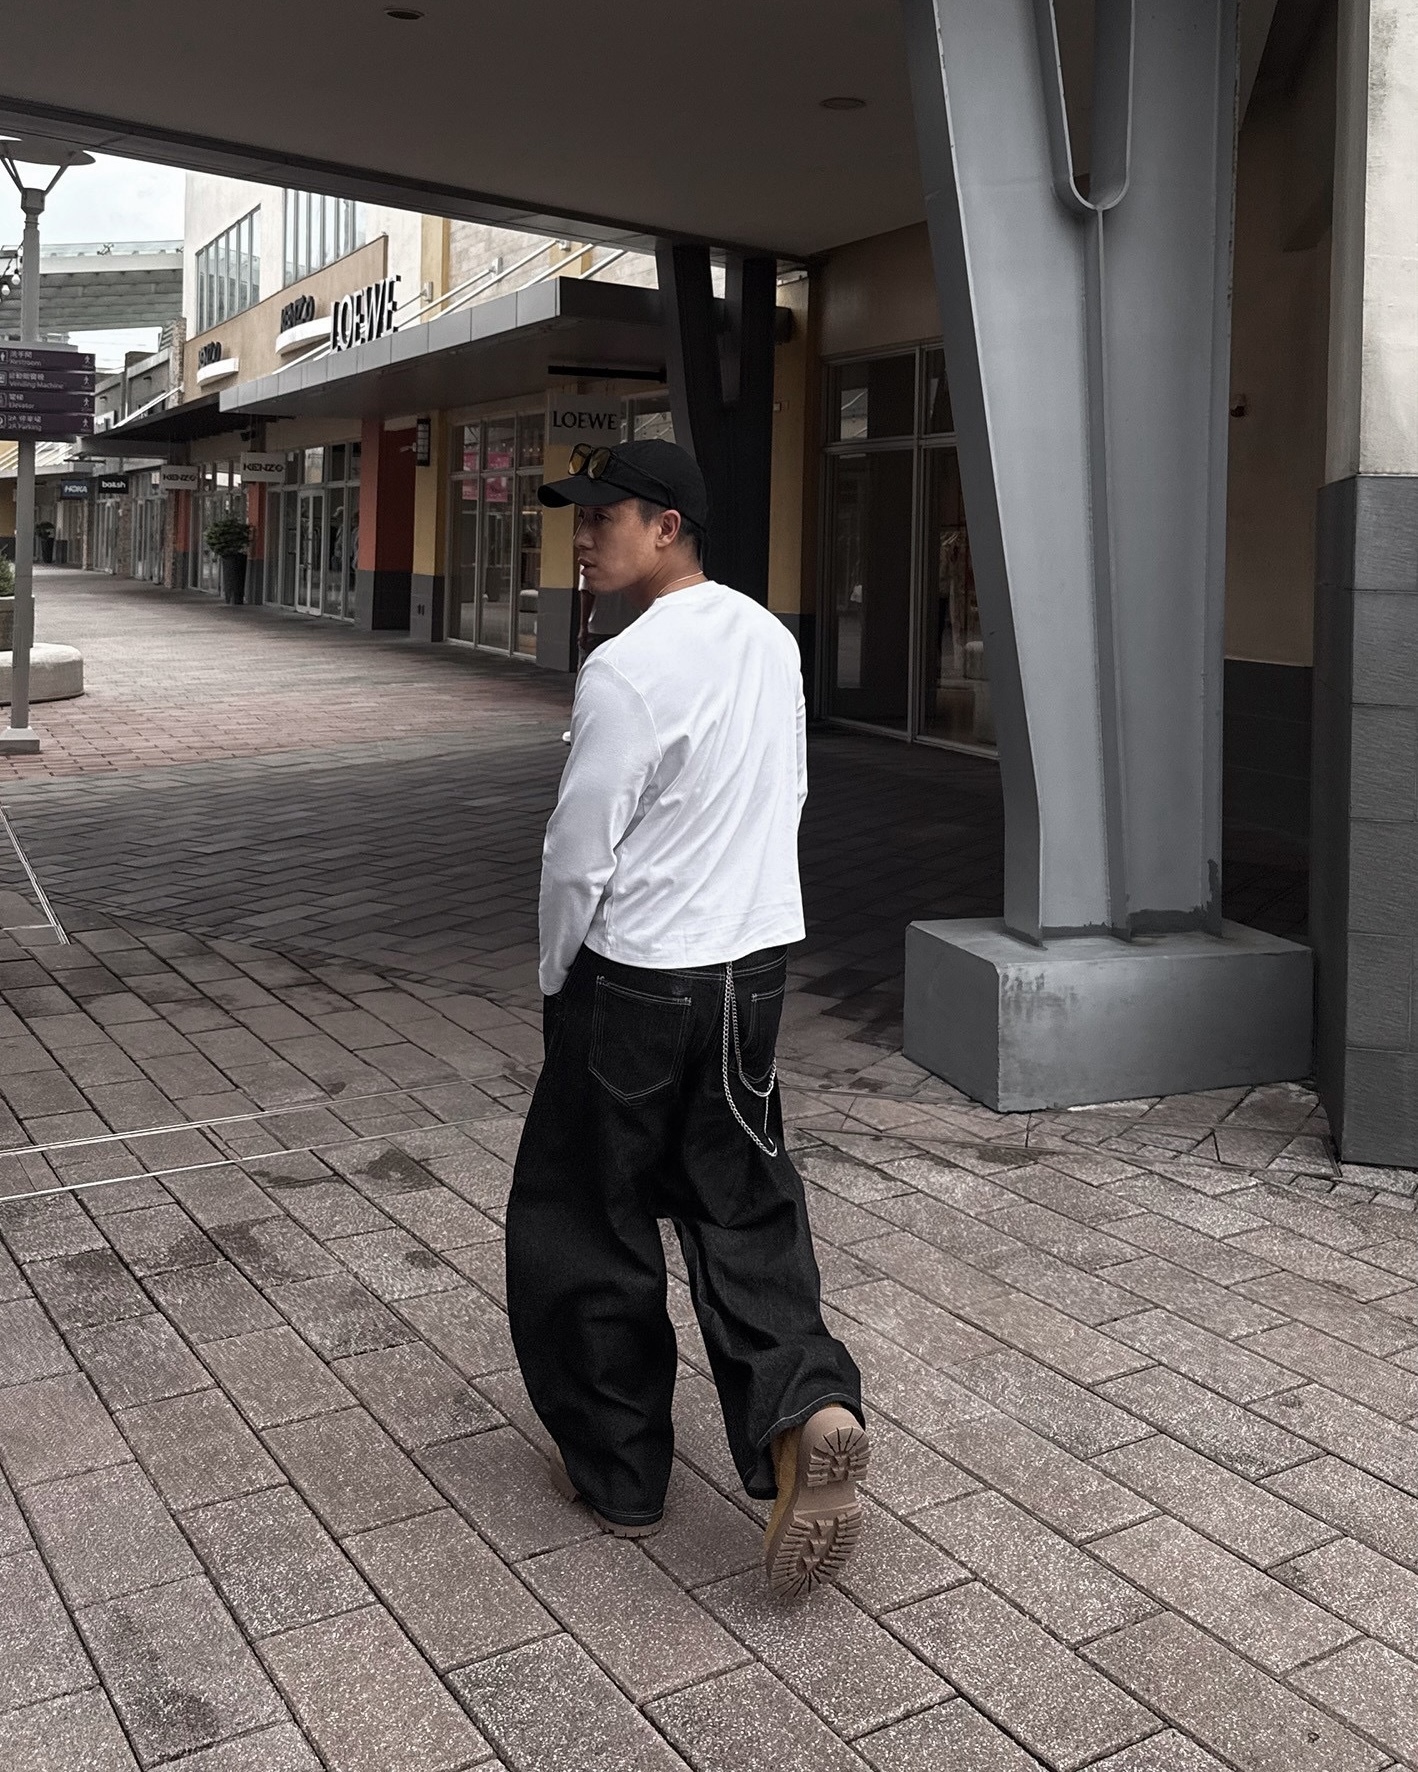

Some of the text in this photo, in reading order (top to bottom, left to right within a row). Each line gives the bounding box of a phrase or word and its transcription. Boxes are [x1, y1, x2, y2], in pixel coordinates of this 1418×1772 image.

[331, 275, 401, 352] LOEWE
[9, 381, 36, 389] Vending
[553, 411, 617, 430] LOEWE
[243, 463, 284, 473] KENZO
[163, 473, 196, 482] KENZO
[64, 484, 88, 493] HOKA
